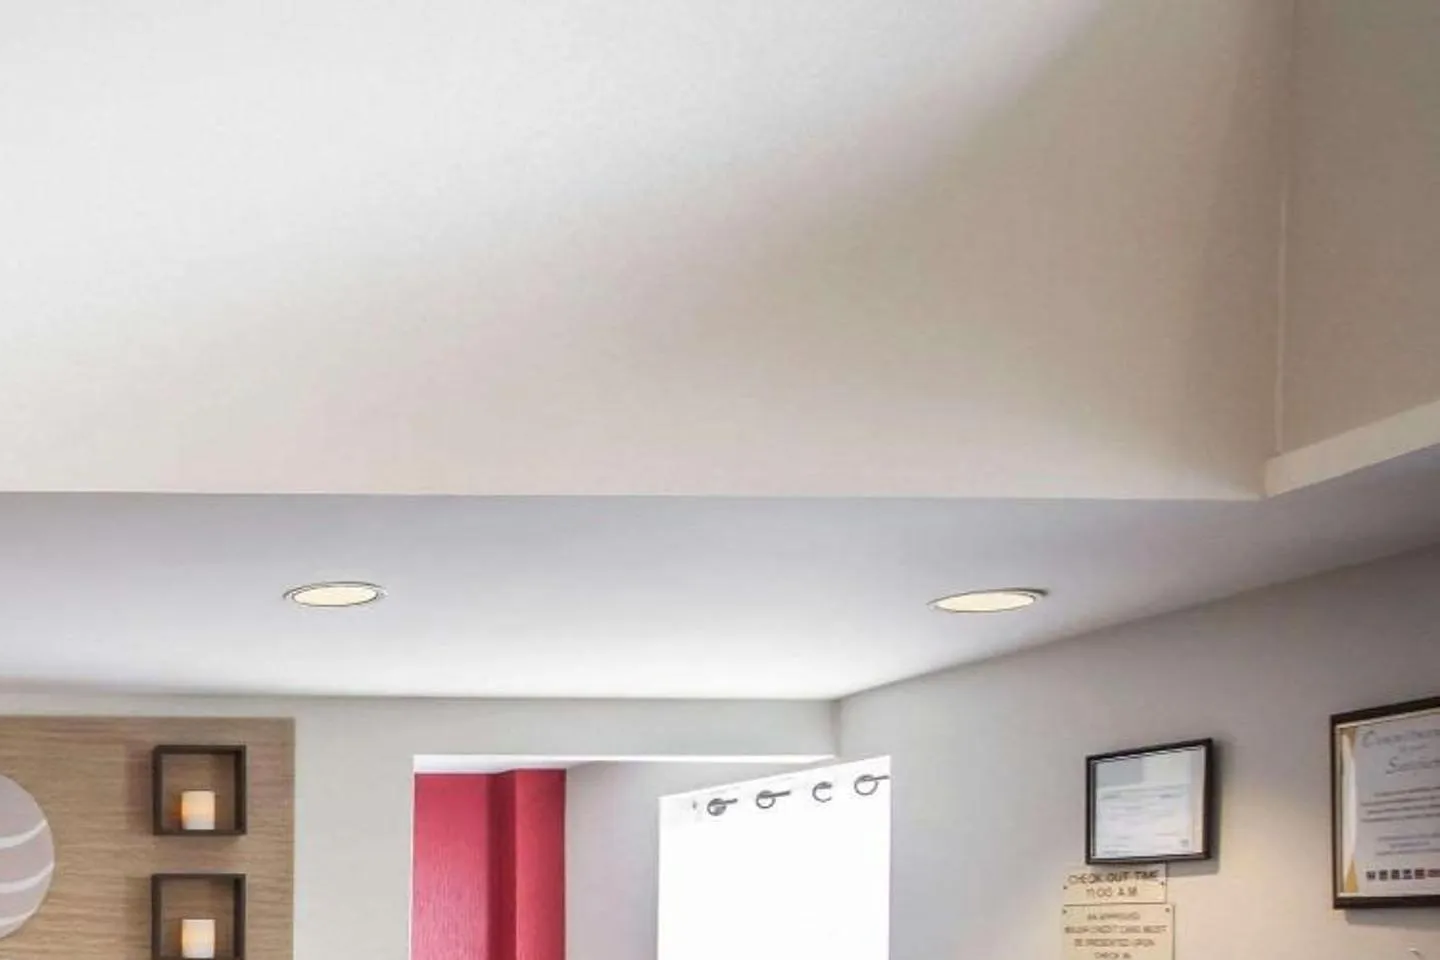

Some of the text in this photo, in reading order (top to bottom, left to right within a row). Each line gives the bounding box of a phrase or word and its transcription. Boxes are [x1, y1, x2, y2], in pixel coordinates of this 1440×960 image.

[1067, 869, 1160, 885] CHECK OUT TIME
